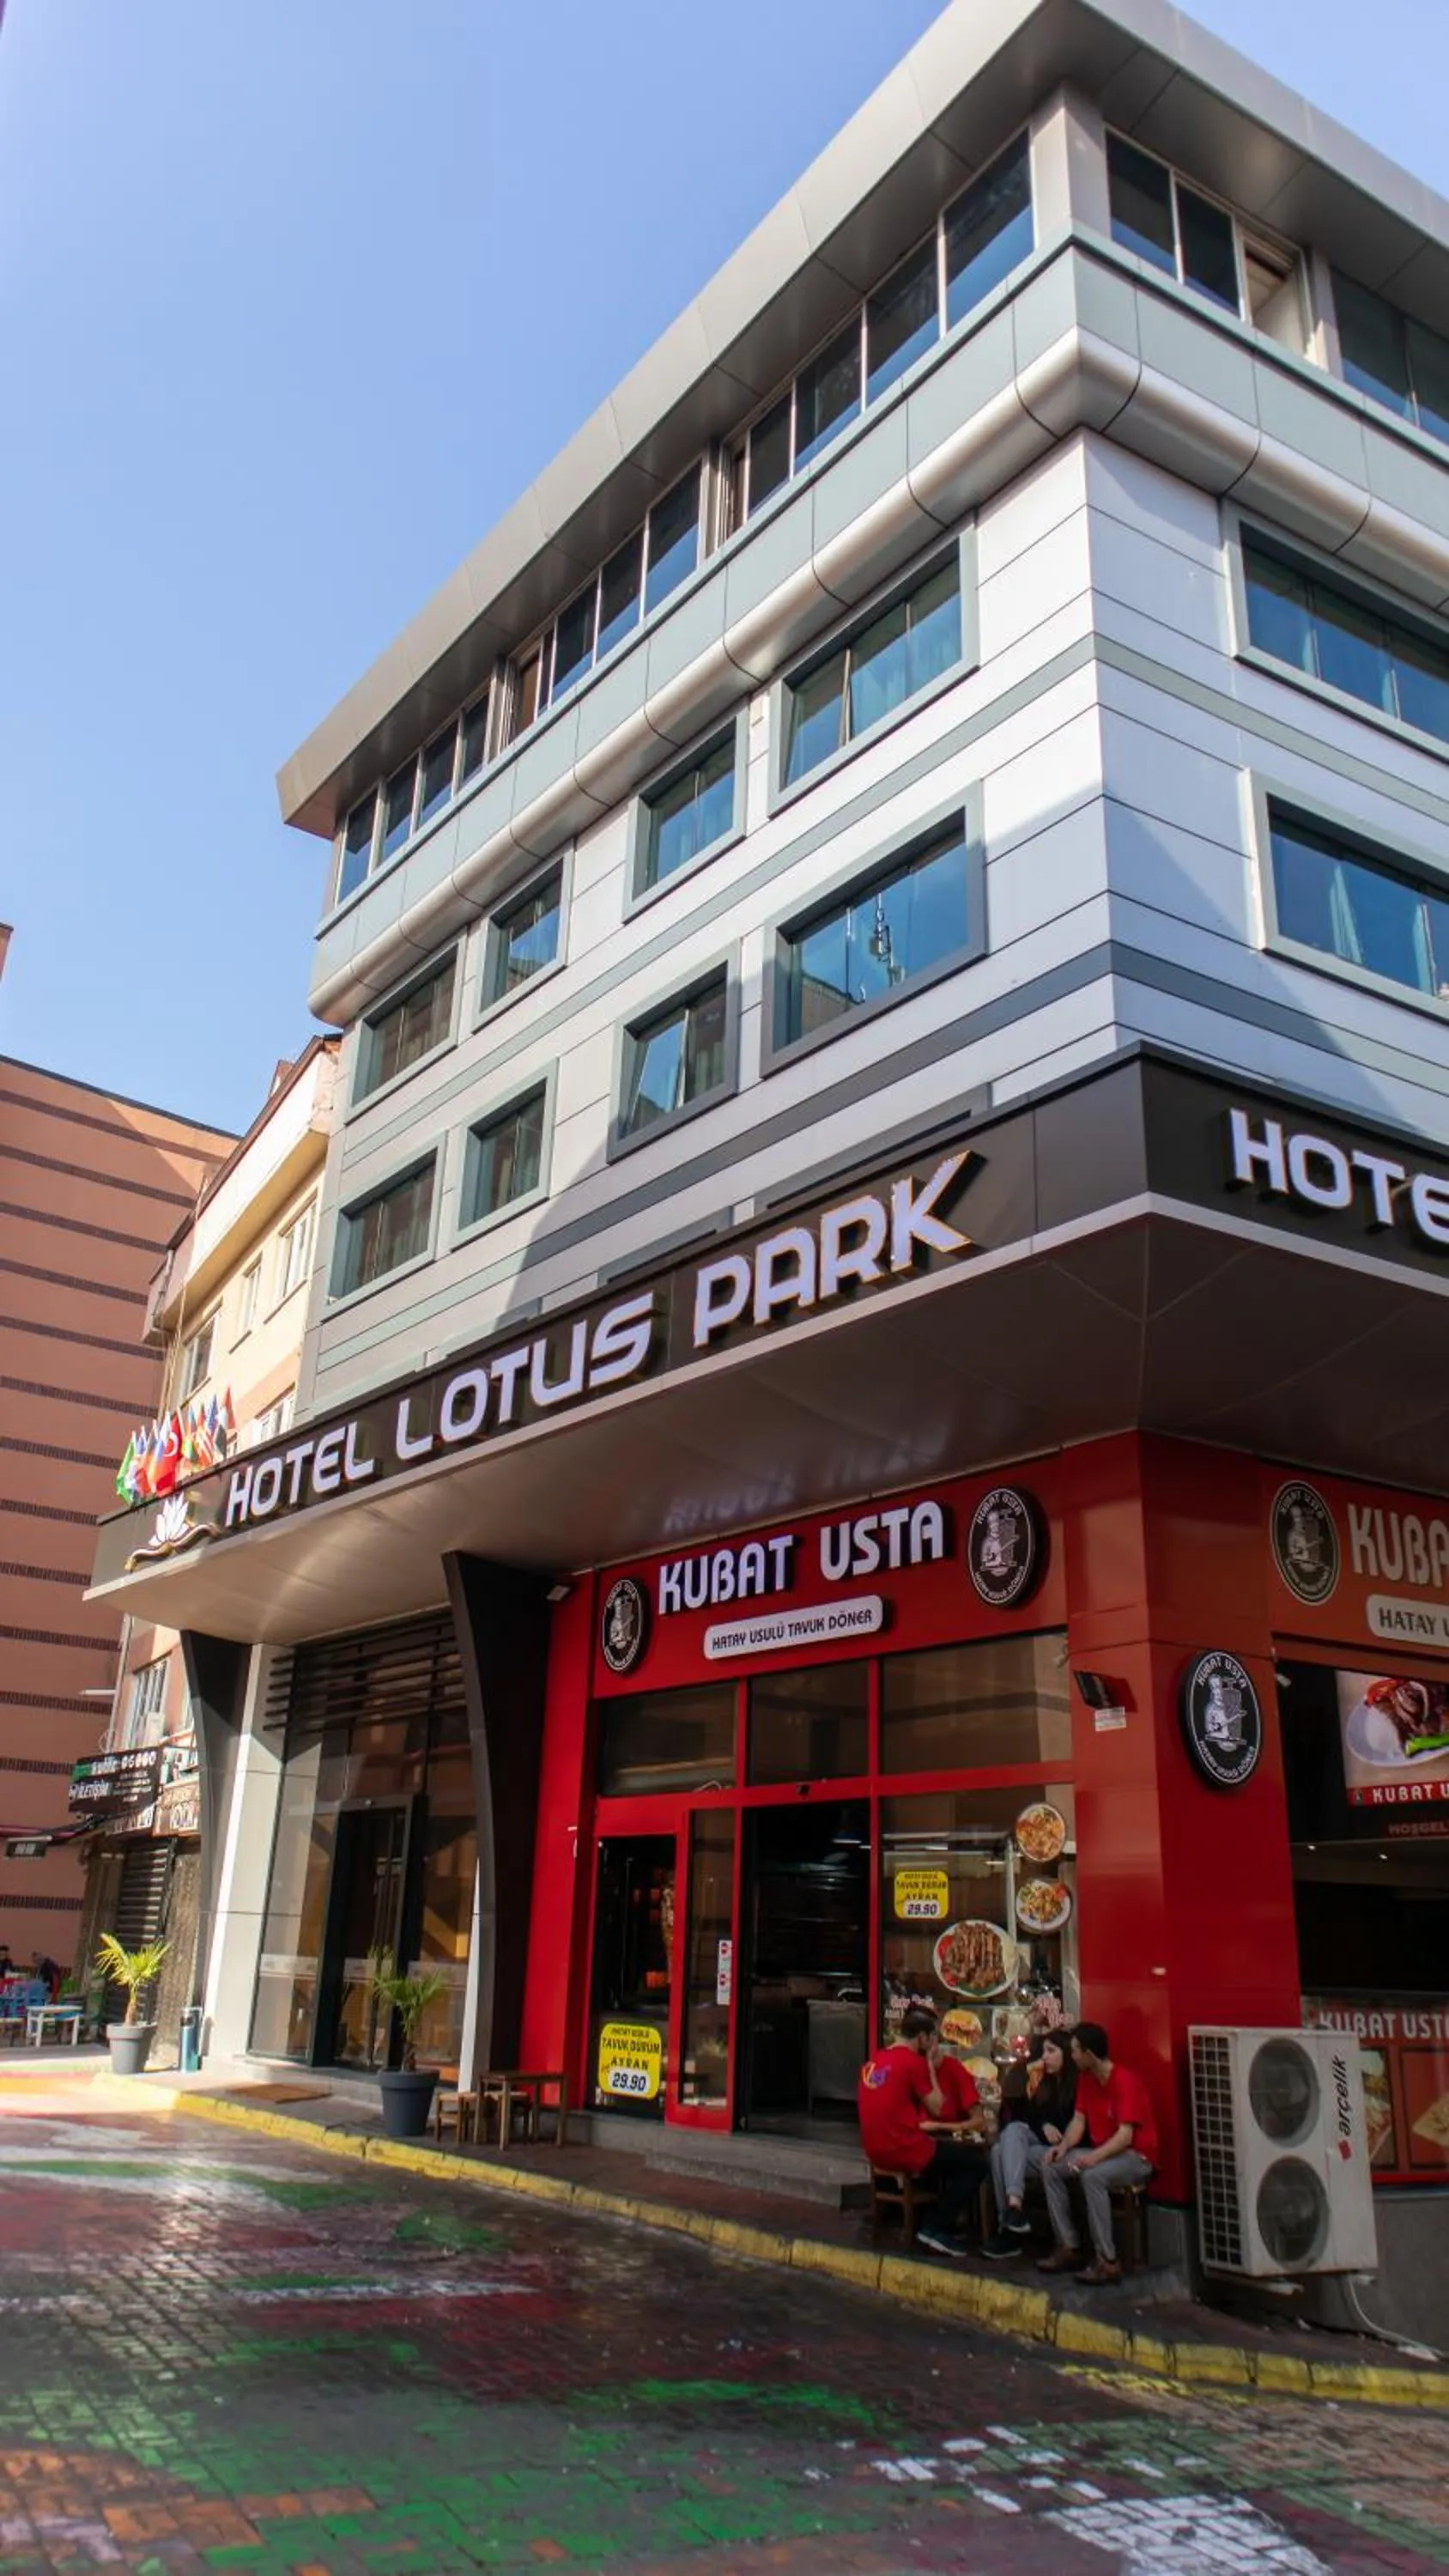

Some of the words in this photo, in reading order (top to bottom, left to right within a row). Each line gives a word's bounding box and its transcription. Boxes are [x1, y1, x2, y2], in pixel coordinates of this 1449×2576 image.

[225, 1421, 374, 1528] HOTEL
[396, 1291, 654, 1460] LOTUS
[694, 1150, 973, 1348] PARK
[658, 1534, 794, 1616] KUBAT
[821, 1501, 944, 1581] USTA
[712, 1631, 747, 1650] HATAY
[749, 1620, 785, 1643] USULÜ
[787, 1617, 825, 1636] TAVUK
[828, 1608, 873, 1630] DÖNER
[1379, 1607, 1436, 1635] HATAY
[1197, 1656, 1222, 1687] KUBAT
[1225, 1659, 1247, 1688] USTA
[1373, 1783, 1434, 1803] KUBAT
[610, 2056, 648, 2070] AYRAN
[612, 2071, 646, 2092] 29.90
[1332, 2055, 1354, 2137] arçelik
